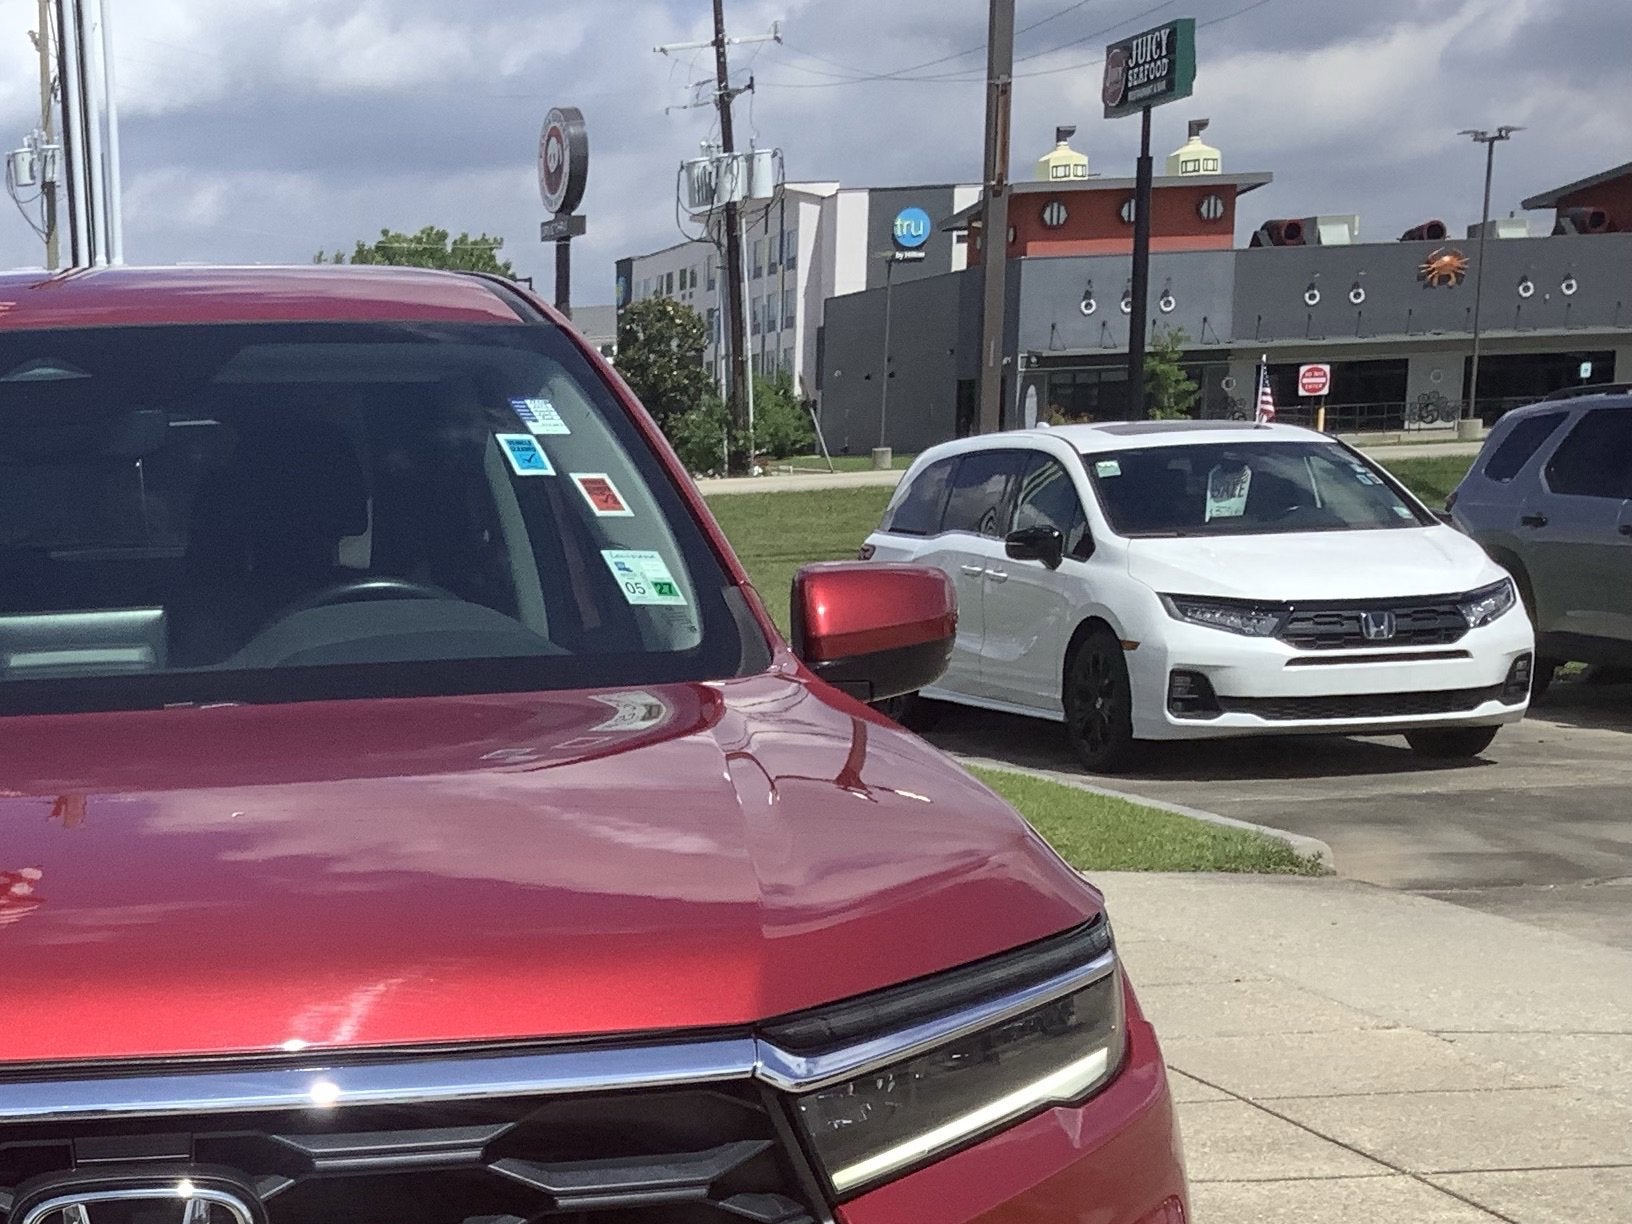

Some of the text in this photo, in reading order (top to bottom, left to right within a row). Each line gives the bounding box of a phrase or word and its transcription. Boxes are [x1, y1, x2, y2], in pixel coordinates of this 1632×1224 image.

[1128, 28, 1170, 67] JUICY
[1127, 58, 1170, 88] SEAFOOD
[894, 218, 924, 237] tru
[625, 581, 674, 595] 05 27
